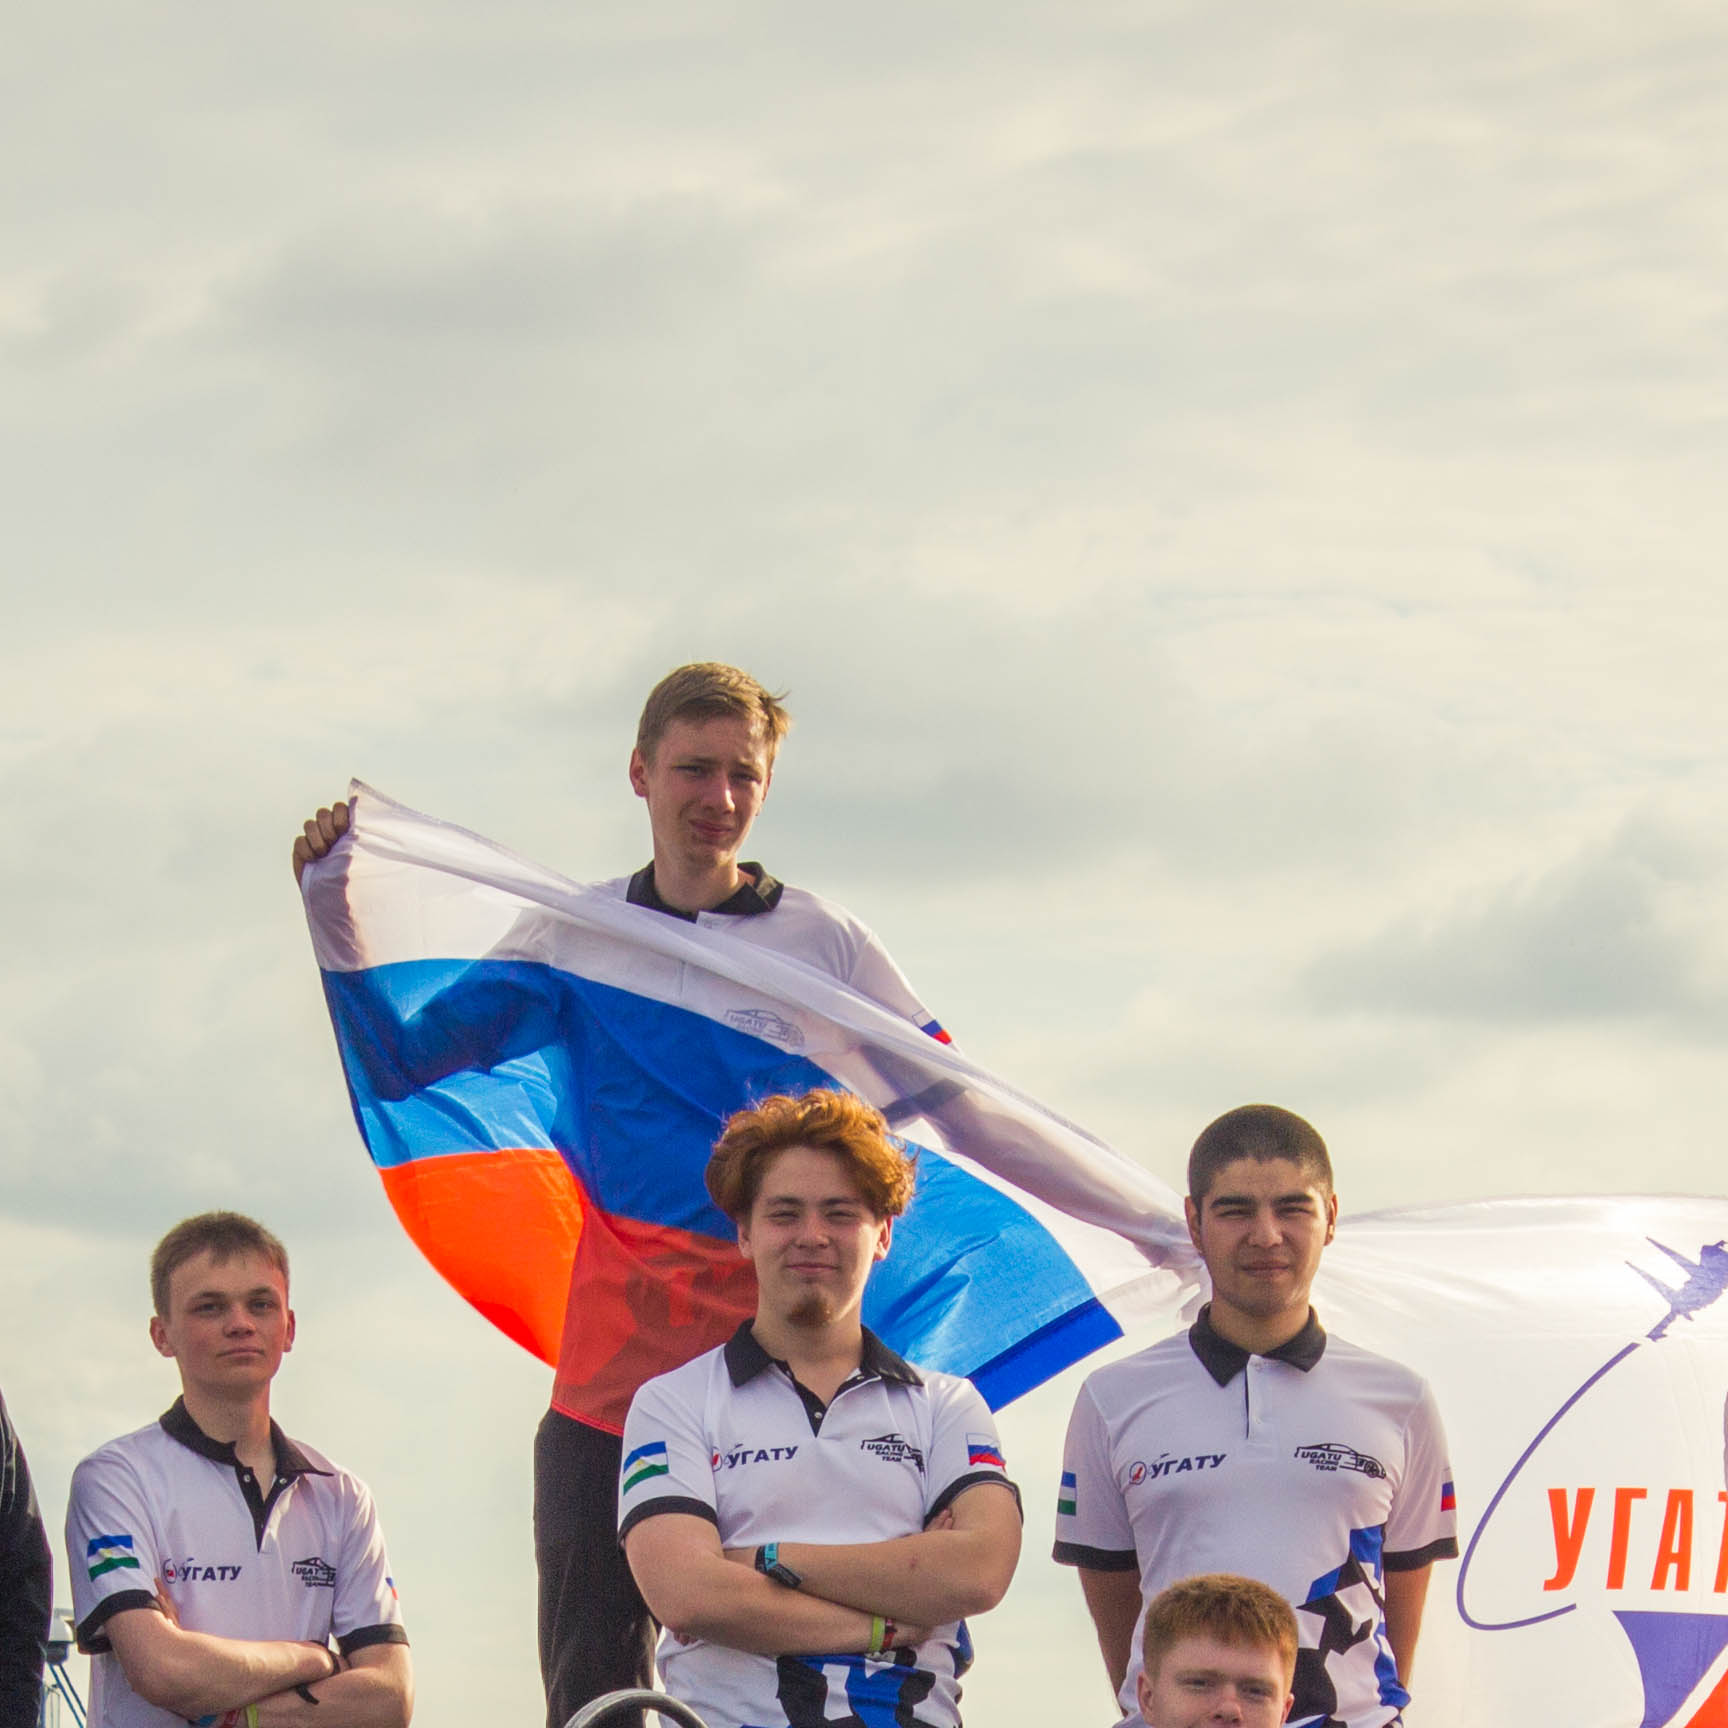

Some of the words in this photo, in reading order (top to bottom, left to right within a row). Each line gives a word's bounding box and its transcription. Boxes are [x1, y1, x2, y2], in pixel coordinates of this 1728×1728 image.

[866, 1443, 907, 1452] UGATU
[1300, 1451, 1342, 1461] UGATU
[727, 1445, 800, 1469] УГАТУ
[1150, 1453, 1227, 1479] УГАТУ
[181, 1564, 242, 1582] УГАТУ
